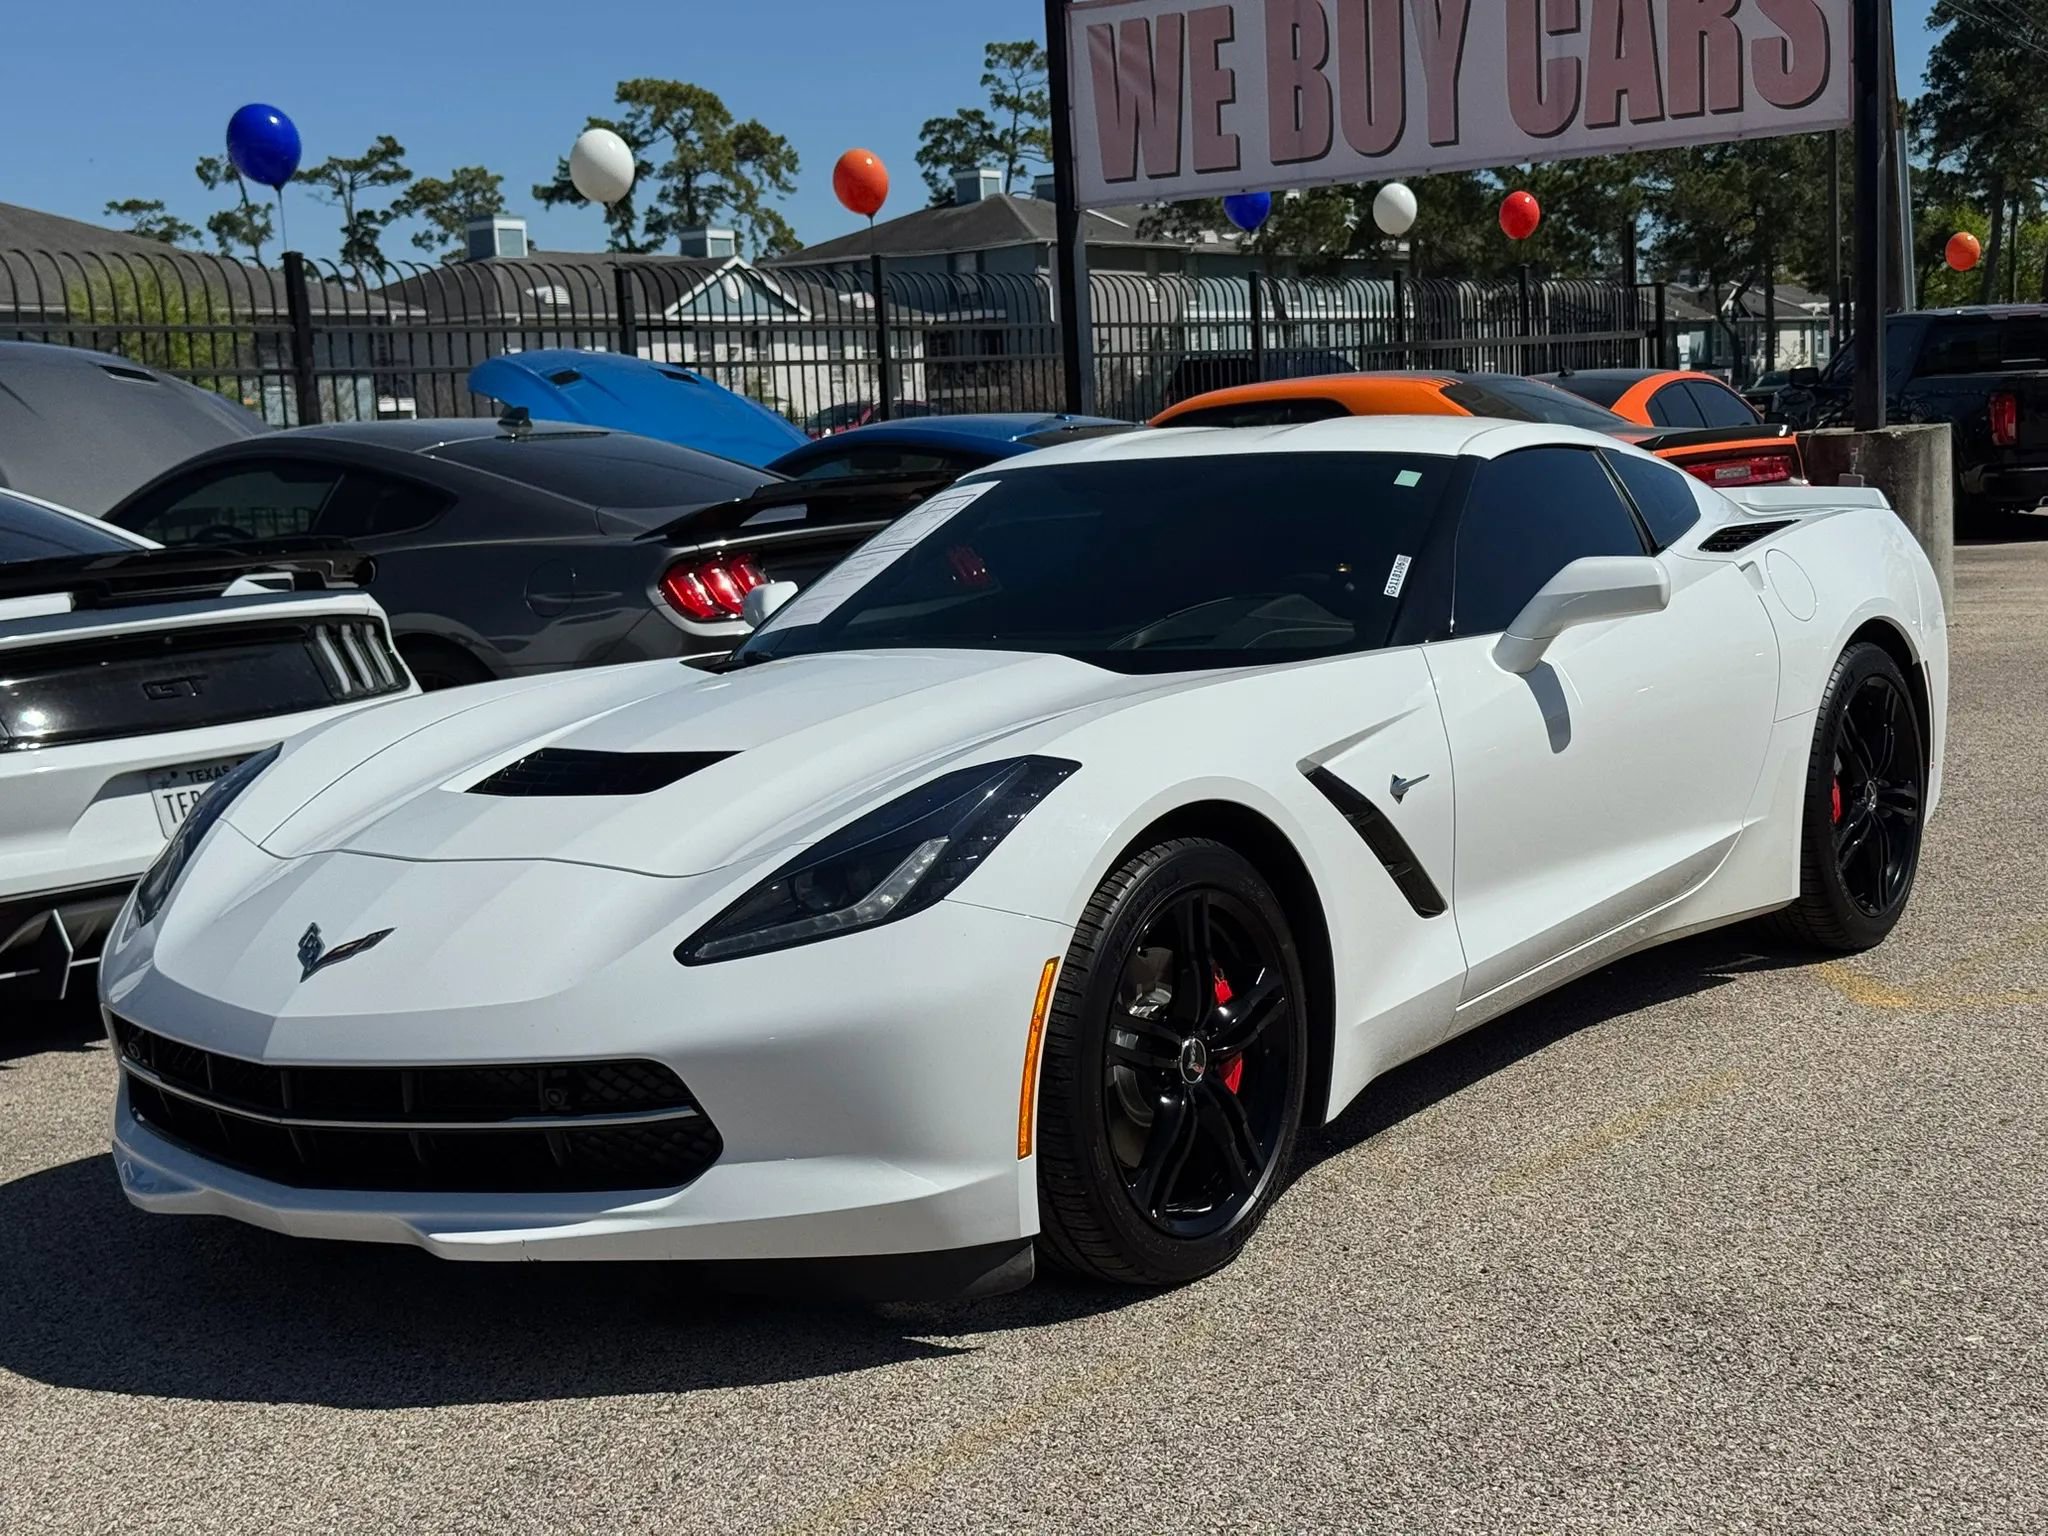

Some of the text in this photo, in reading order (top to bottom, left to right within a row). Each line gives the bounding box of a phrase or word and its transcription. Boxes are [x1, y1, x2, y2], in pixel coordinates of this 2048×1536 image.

[1086, 0, 1831, 184] WE BUY CARS
[142, 673, 209, 701] GT
[187, 765, 230, 784] TEXAS
